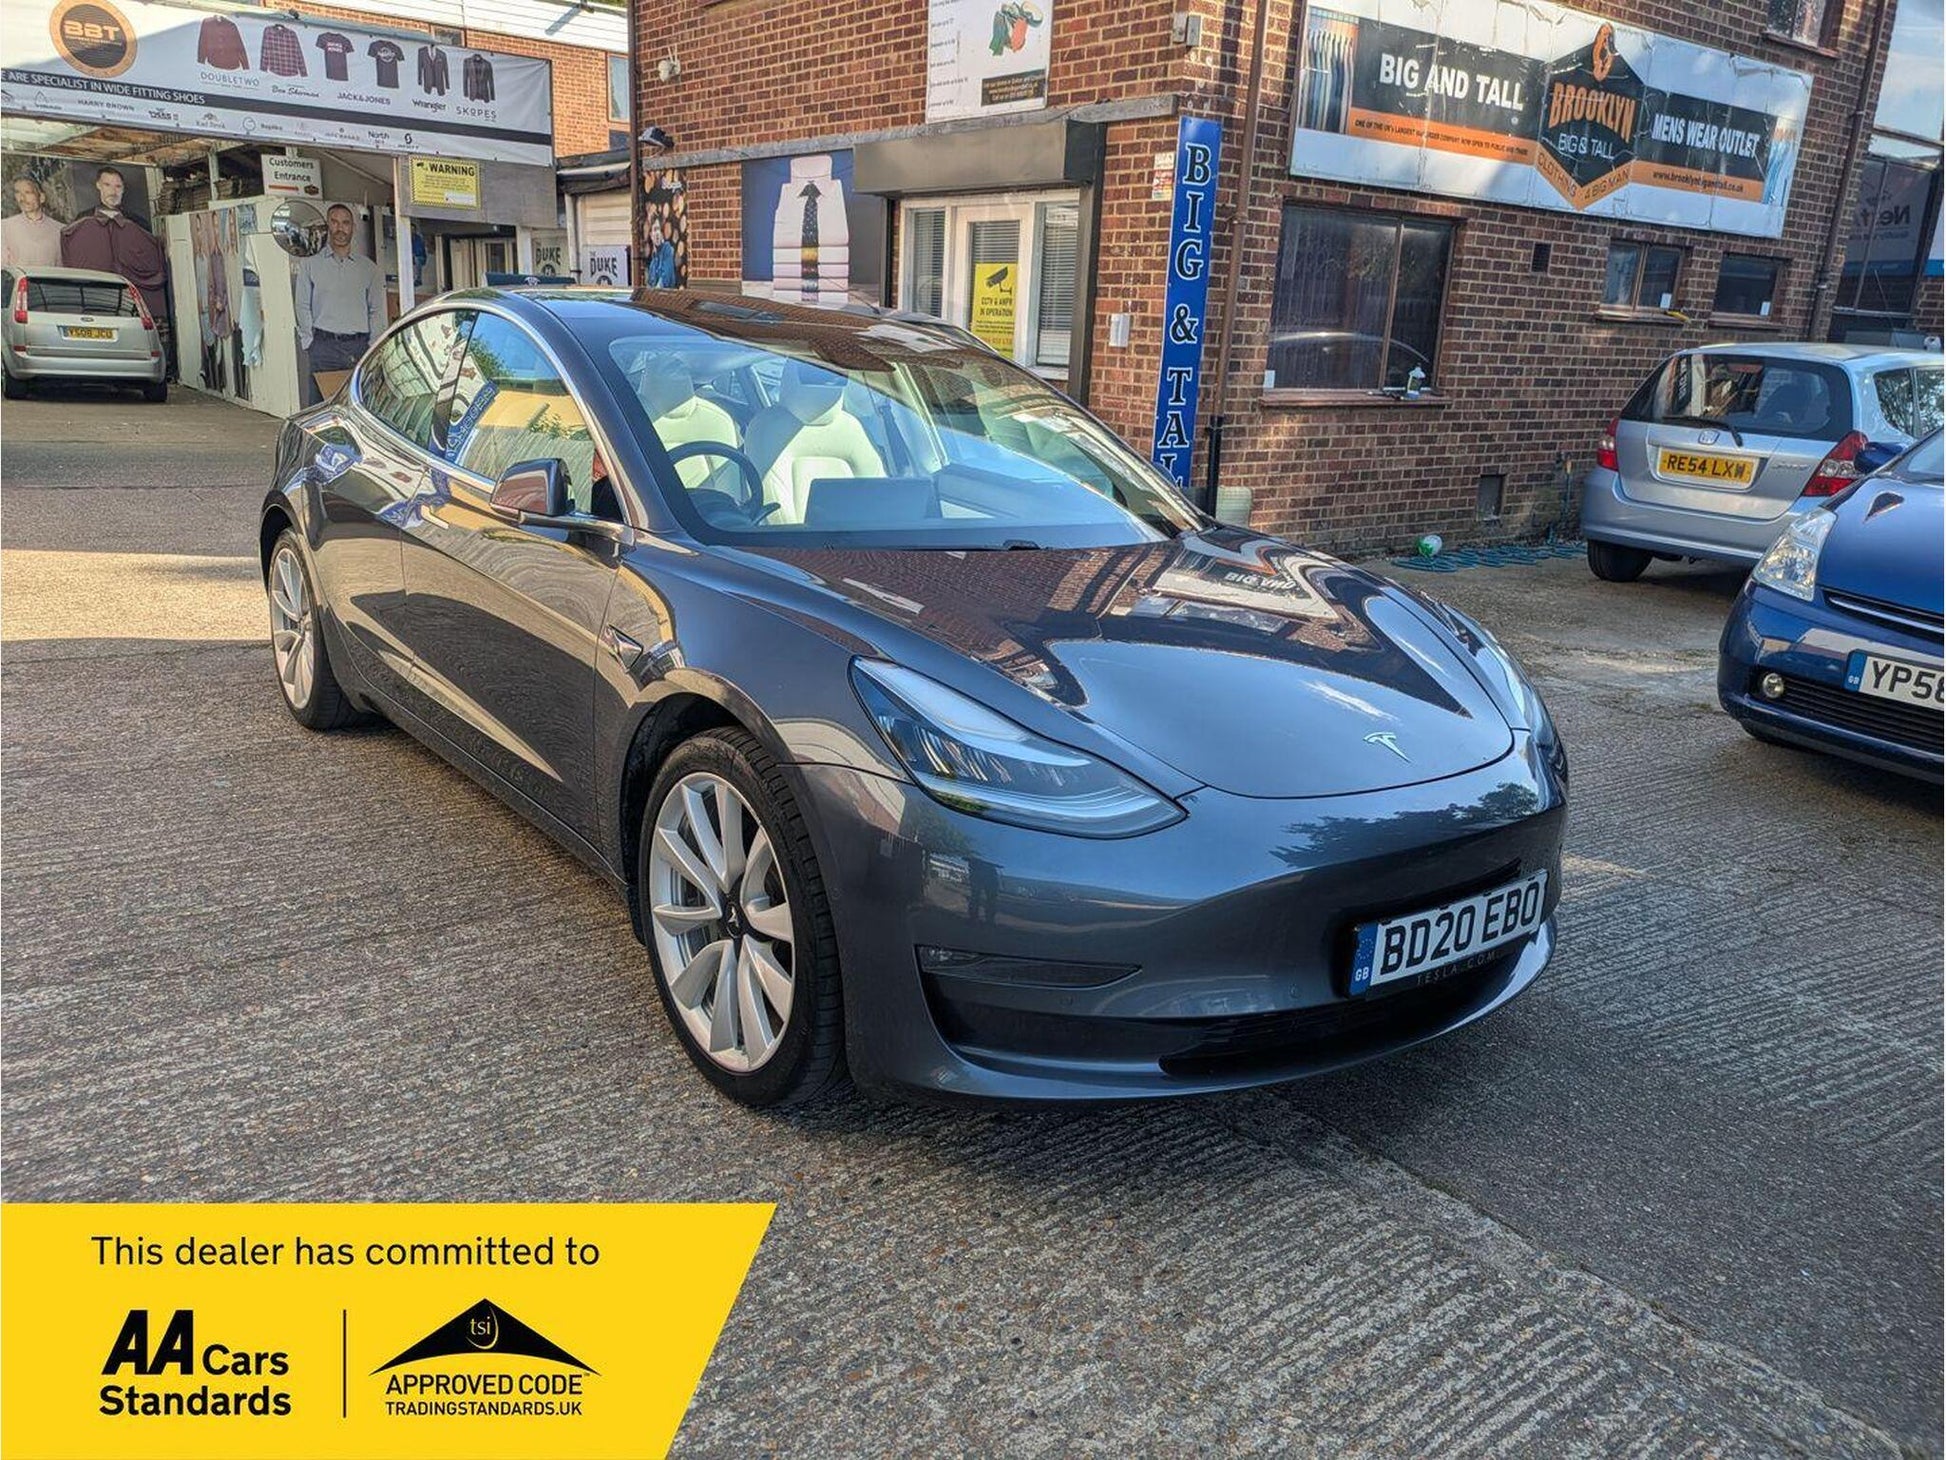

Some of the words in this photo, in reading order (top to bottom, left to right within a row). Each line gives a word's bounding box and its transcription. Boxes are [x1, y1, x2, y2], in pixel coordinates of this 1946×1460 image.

[64, 20, 120, 41] BBT
[9, 71, 29, 83] ARE
[31, 74, 88, 89] SPECIALIST
[91, 81, 101, 91] IN
[103, 83, 131, 94] WIDE
[133, 86, 171, 100] FITTING
[173, 92, 206, 104] SHOES
[200, 72, 260, 87] DOUBLETWO
[1379, 53, 1420, 89] BIG
[1424, 64, 1469, 100] AND
[1476, 74, 1524, 111] TALL
[411, 98, 447, 113] Wrangler
[456, 106, 497, 120] SKOPES
[1548, 82, 1636, 143] BROOKLYN
[1651, 113, 1686, 147] MENS
[1687, 119, 1718, 151] WEAR
[1718, 127, 1760, 159] OUTLET
[1591, 138, 1615, 160] TALL
[269, 157, 314, 170] Customers
[429, 163, 475, 176] WARNING
[274, 171, 312, 182] Entrance
[1174, 143, 1212, 281] BIG
[535, 246, 562, 267] DUKE
[590, 257, 618, 278] DUKE
[1169, 303, 1197, 345] &
[1666, 453, 1707, 474] RE54
[1711, 457, 1746, 479] LXW
[1380, 903, 1476, 976] BD20
[1481, 880, 1540, 944] EBO
[1354, 965, 1369, 982] GB
